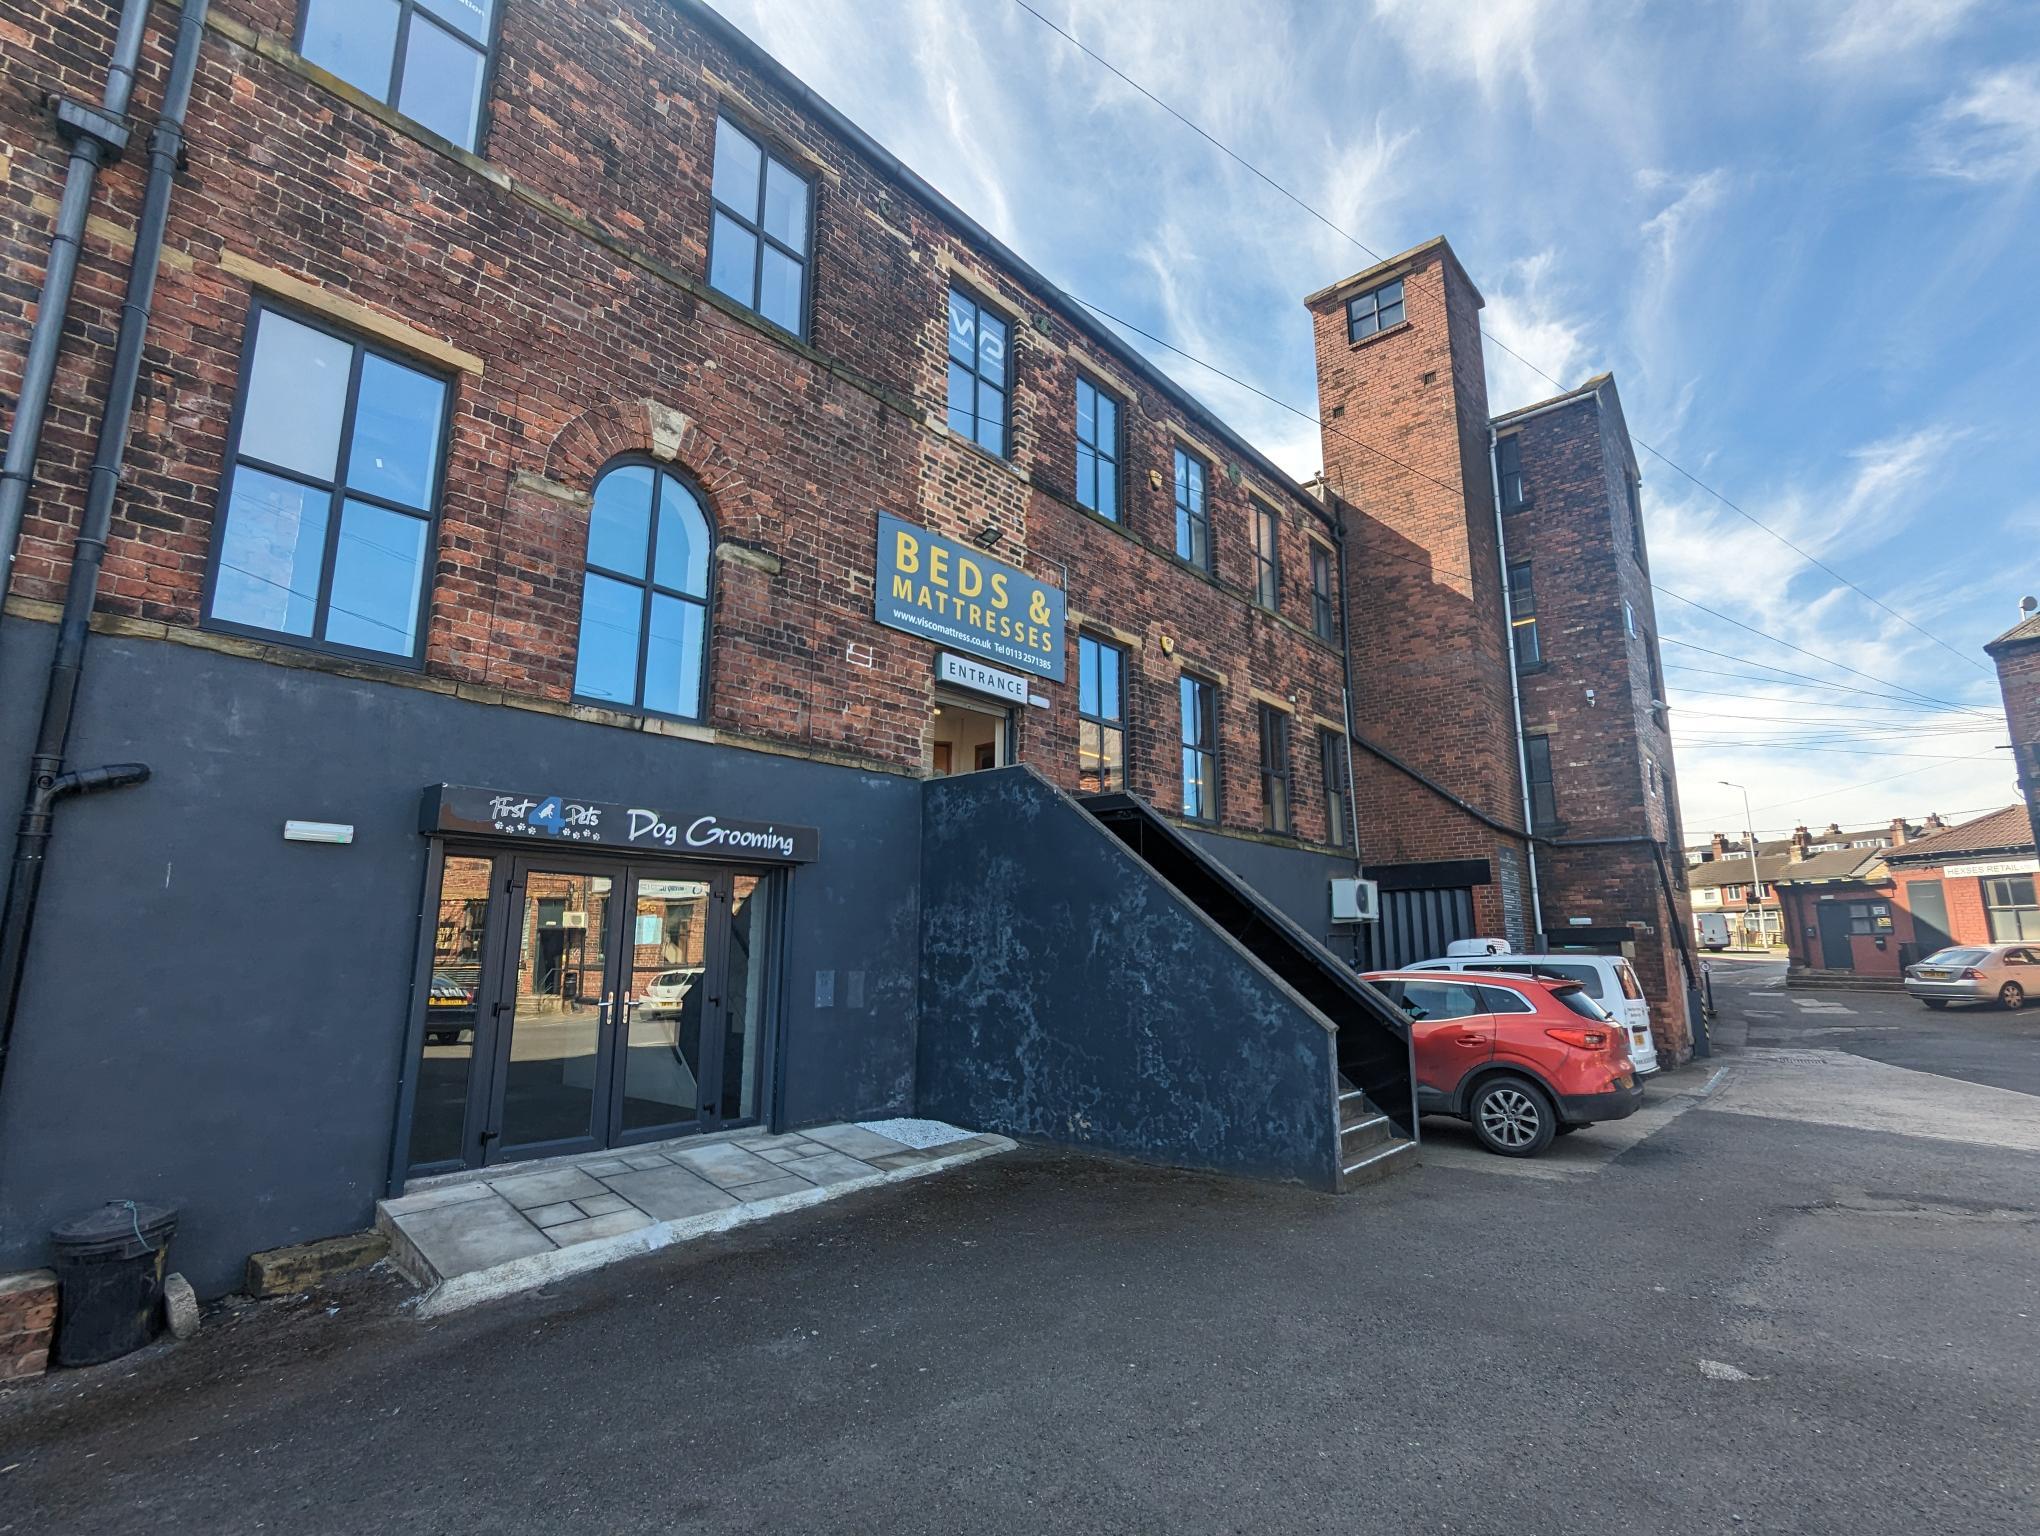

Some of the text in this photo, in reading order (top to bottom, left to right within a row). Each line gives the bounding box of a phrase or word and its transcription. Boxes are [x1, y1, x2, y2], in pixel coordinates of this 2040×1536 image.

[896, 531, 1051, 627] BEDS &
[892, 575, 1052, 652] MATTRESSES
[893, 609, 1051, 670] www.viscomattress.co.uk Tel 0113 2571385
[949, 662, 1022, 695] ENTRANCE
[490, 796, 794, 855] First 4 Pets Dog Grooming
